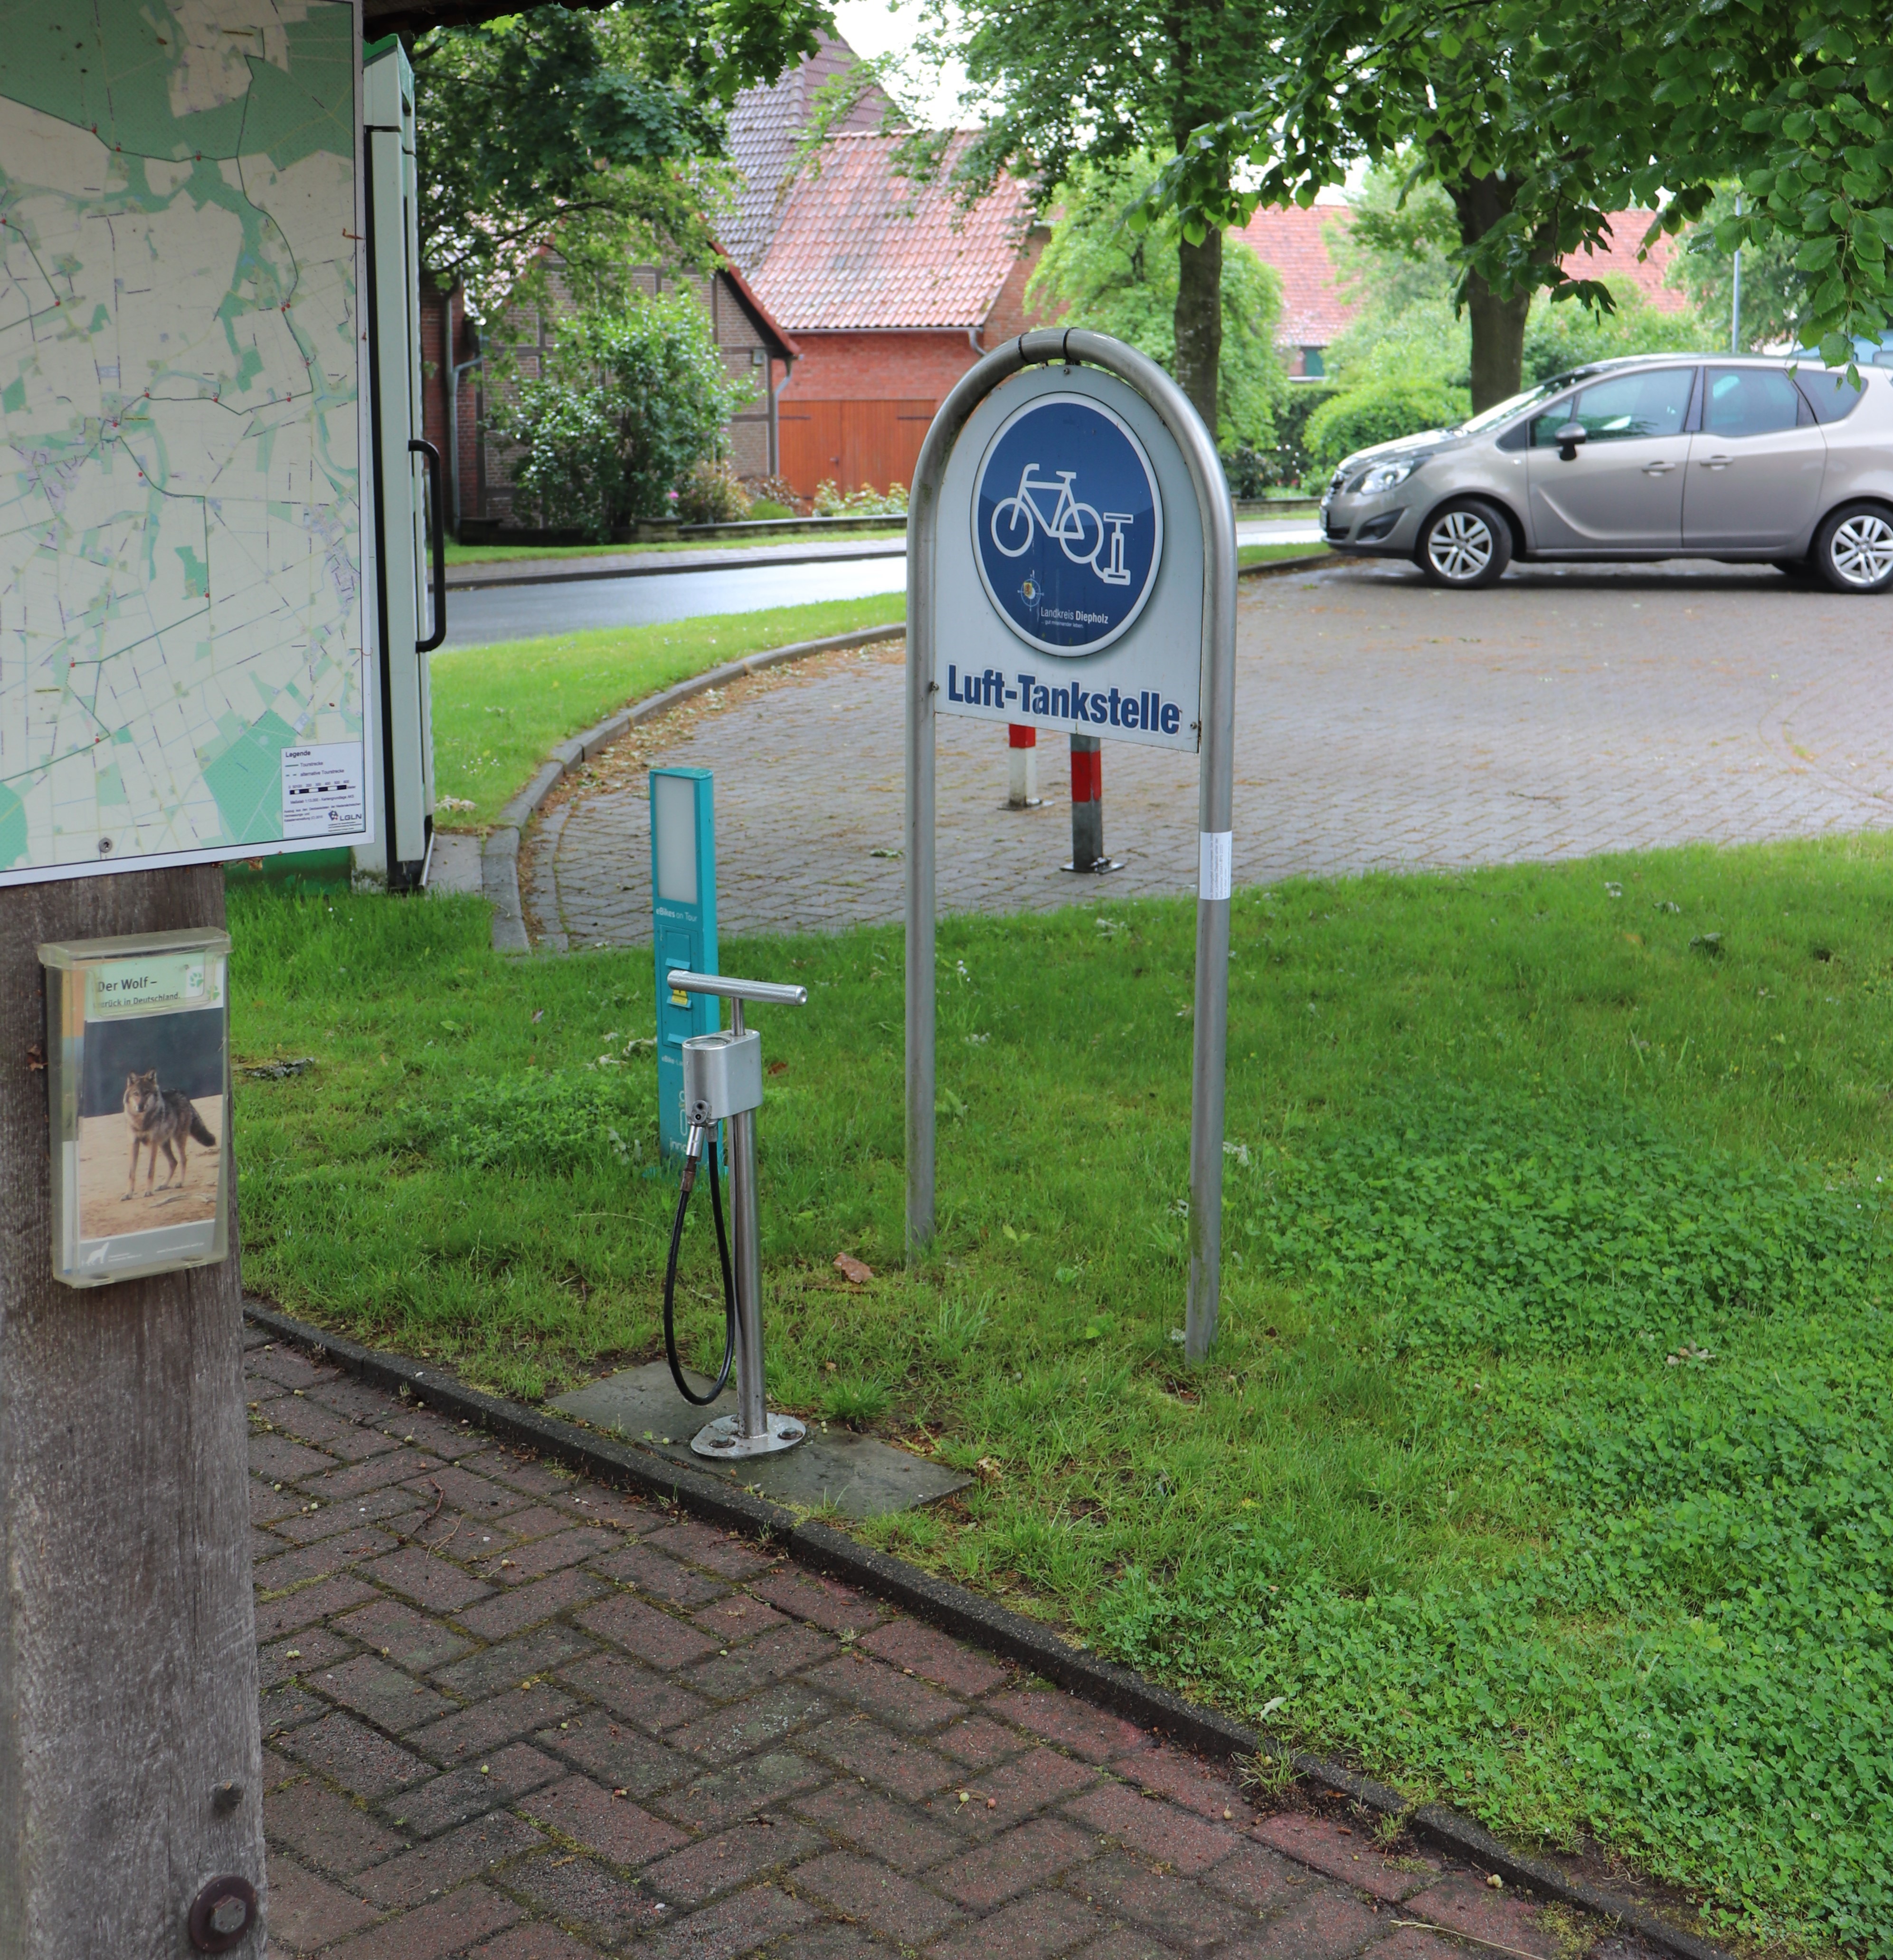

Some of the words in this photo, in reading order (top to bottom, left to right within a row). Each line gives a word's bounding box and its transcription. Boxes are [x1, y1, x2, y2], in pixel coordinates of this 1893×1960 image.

[1041, 607, 1074, 620] Landkreis
[1075, 610, 1108, 624] Diepholz
[948, 665, 1180, 735] Luft-Tankstelle
[285, 750, 311, 758] Legende
[656, 907, 675, 918] eBikes
[684, 912, 698, 922] Tour
[98, 981, 118, 992] Der
[121, 976, 149, 990] Wolf
[94, 999, 122, 1008] rück
[133, 991, 180, 1005] Deutschland.
